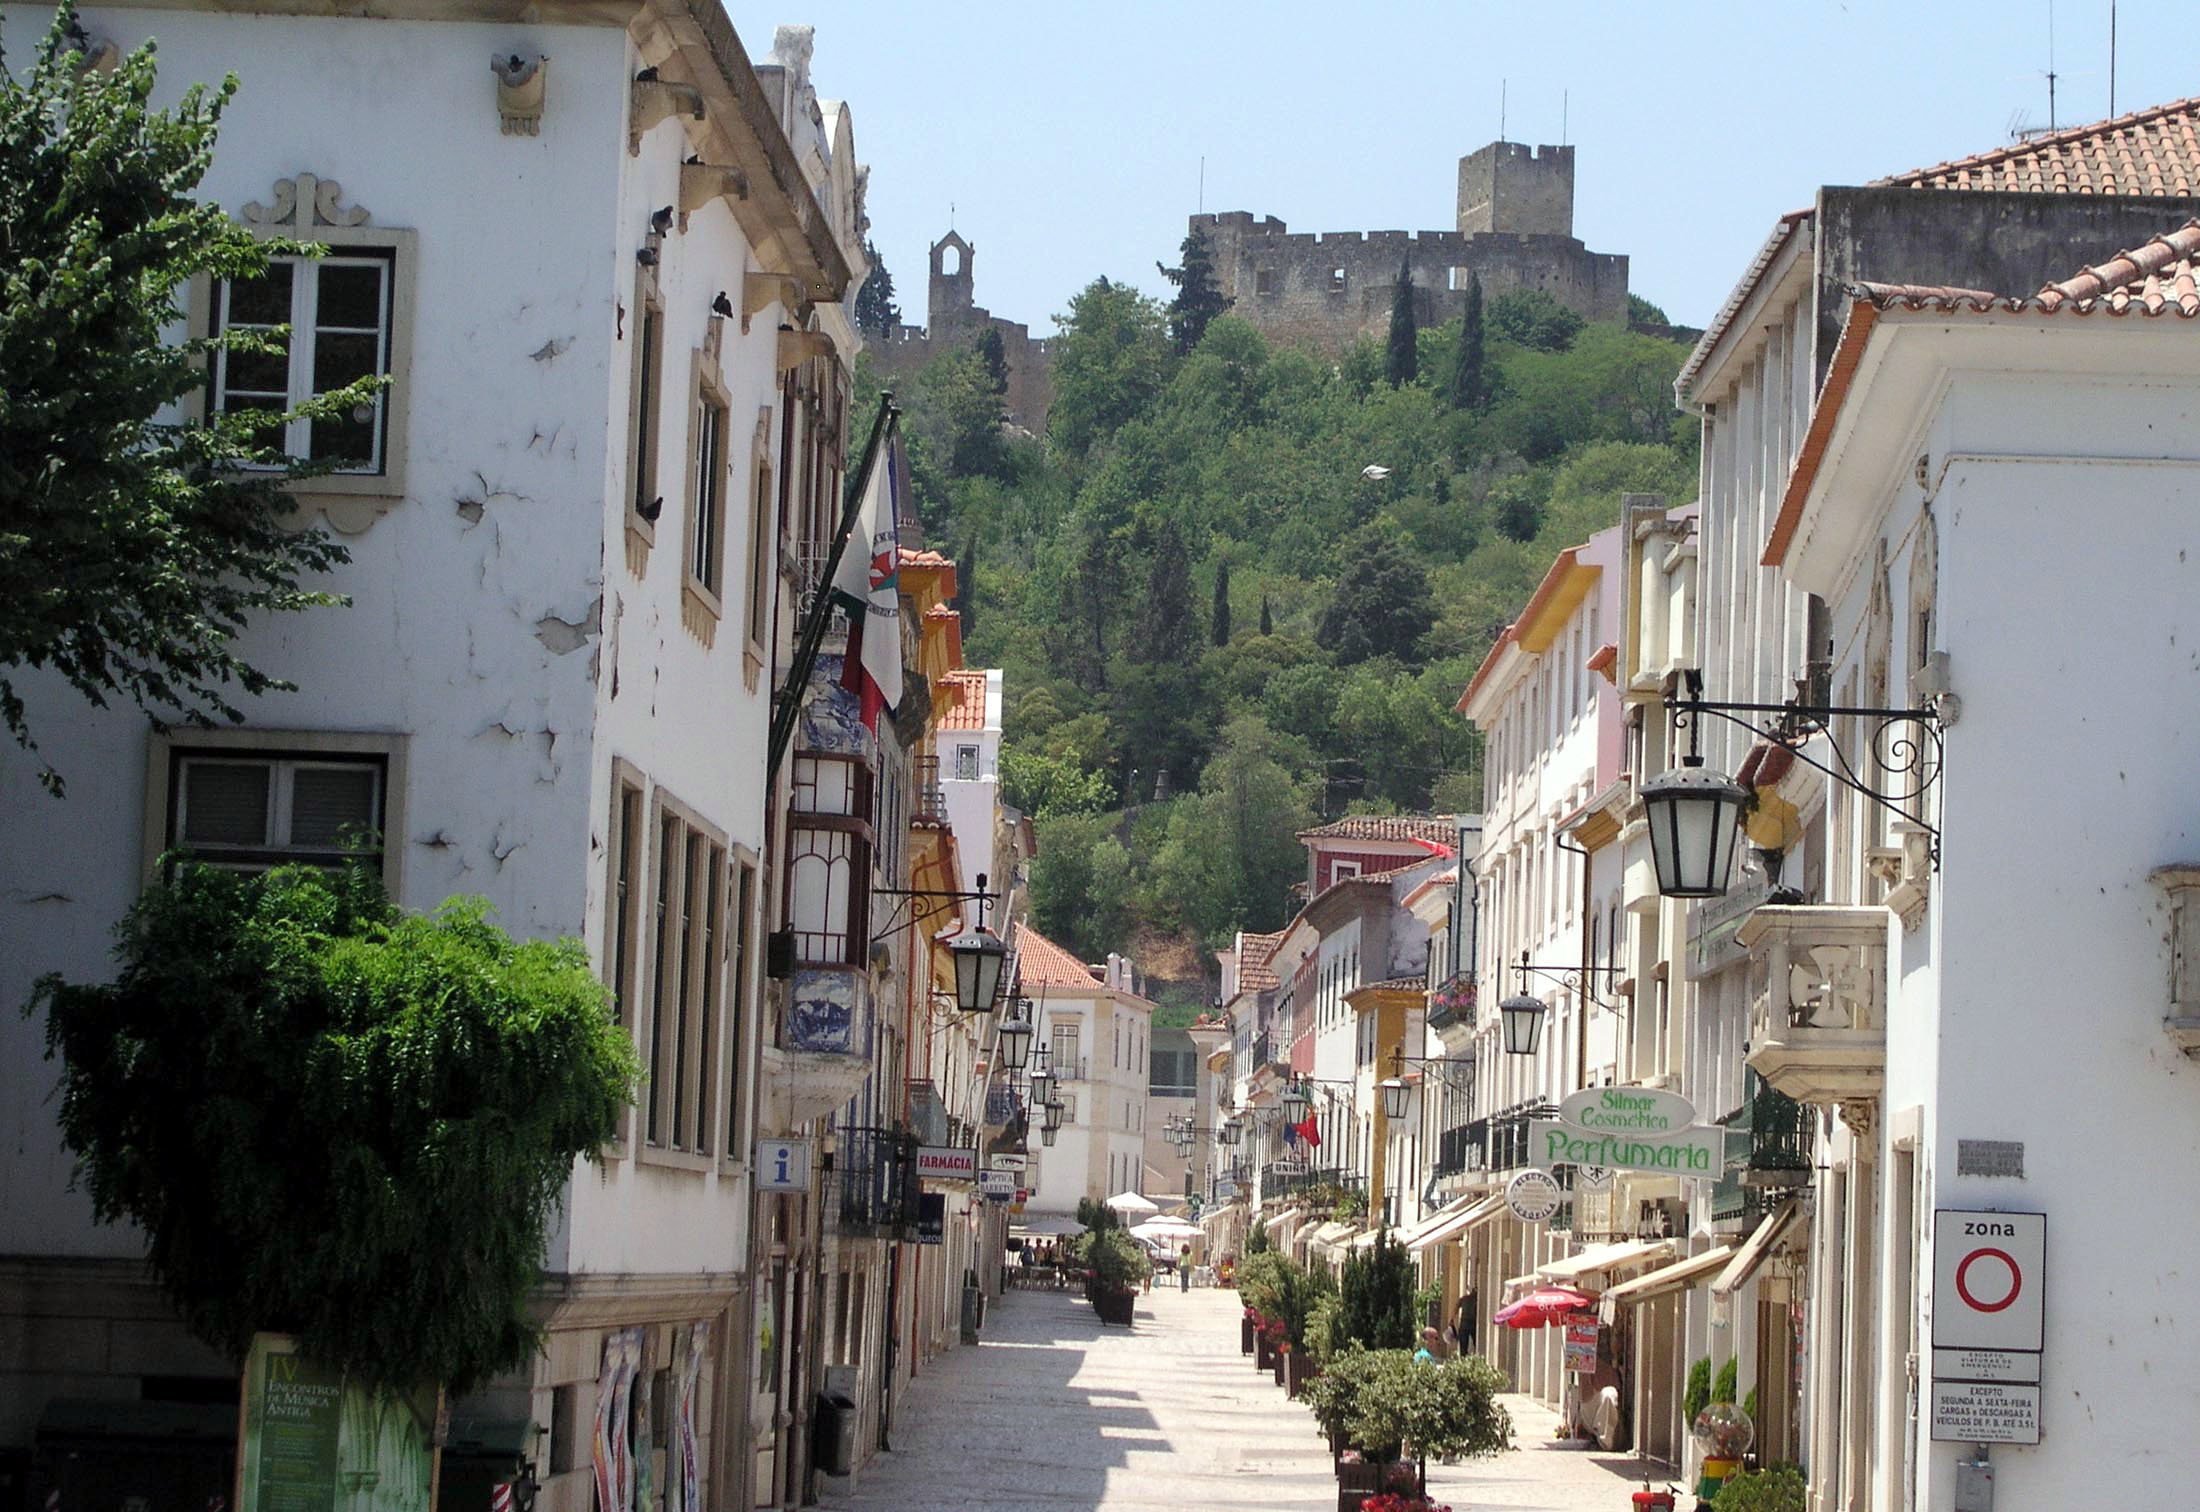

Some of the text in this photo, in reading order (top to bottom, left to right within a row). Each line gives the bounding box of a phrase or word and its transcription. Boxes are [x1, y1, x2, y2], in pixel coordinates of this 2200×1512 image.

[1600, 1089, 1656, 1111] Silmar
[1545, 1129, 1711, 1170] Perfumaria
[919, 1154, 972, 1171] FARMÁCIA
[1964, 1221, 2015, 1237] zona
[1970, 1387, 2003, 1396] EXCEPTO
[1941, 1396, 2032, 1408] SEGUNDA A SEXTA-FEIRA
[1940, 1406, 1970, 1415] CARGAS
[1979, 1407, 2024, 1417] DESCARGAS
[2026, 1409, 2032, 1418] A
[1973, 1418, 1983, 1426] DE
